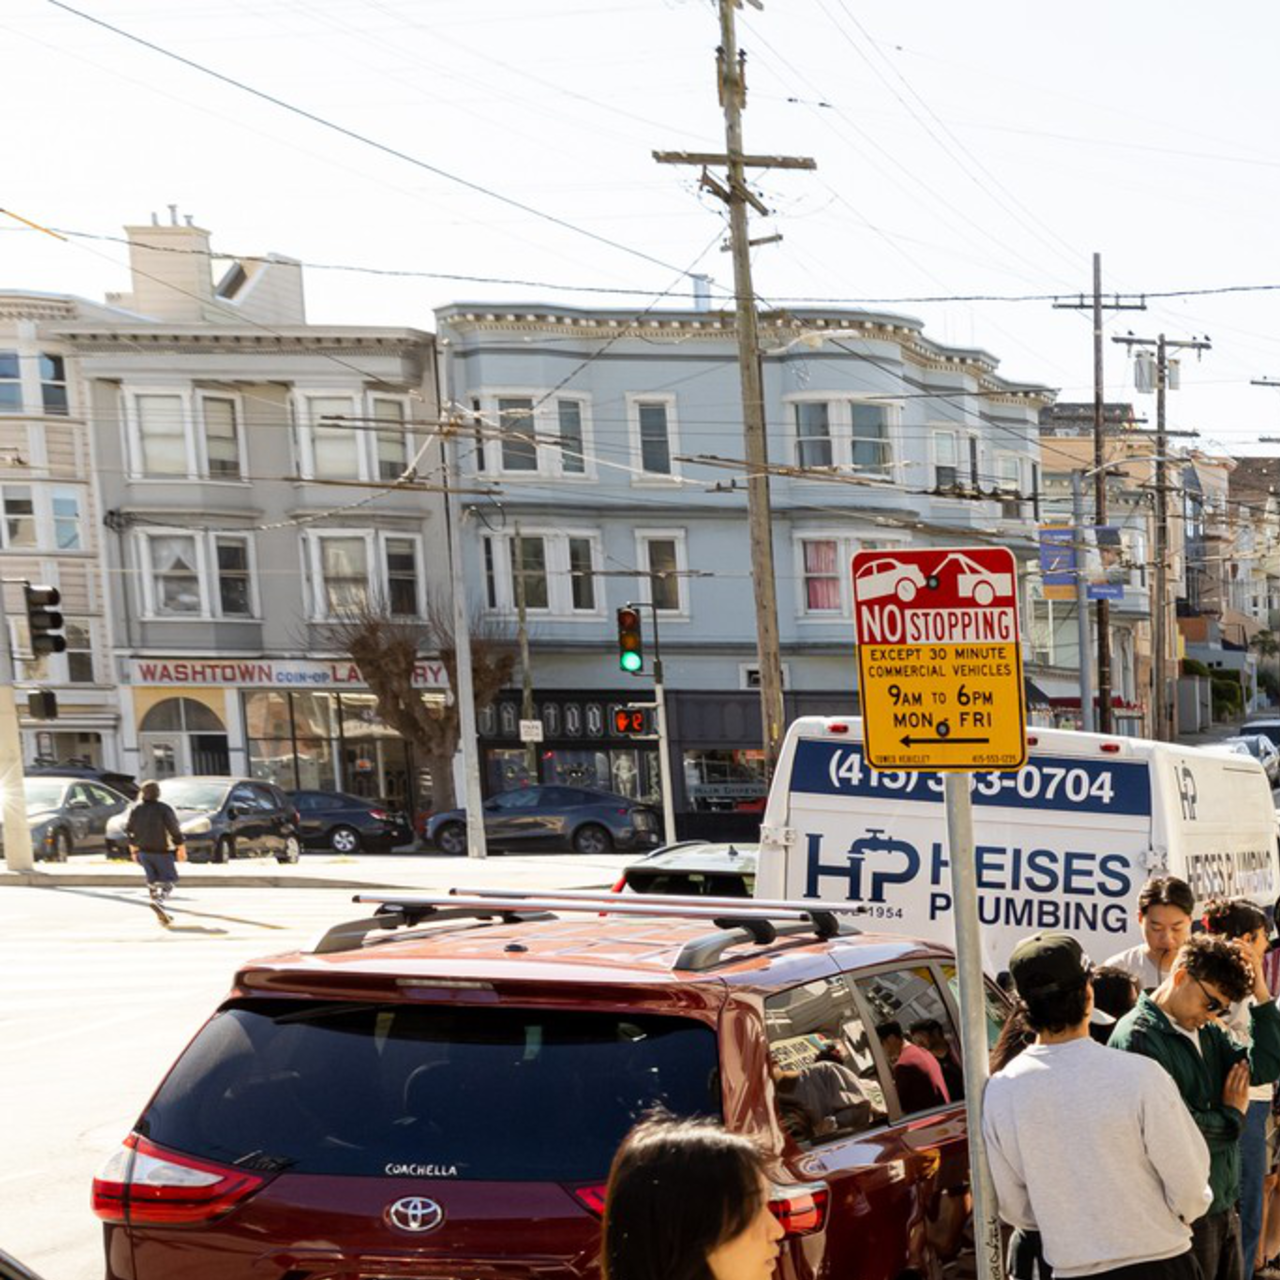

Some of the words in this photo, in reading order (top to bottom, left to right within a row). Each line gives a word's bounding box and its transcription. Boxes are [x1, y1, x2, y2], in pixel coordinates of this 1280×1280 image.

[860, 604, 902, 644] NO
[910, 610, 1011, 642] STOPPING
[870, 648, 922, 661] EXCEPT
[929, 648, 948, 660] 30
[955, 647, 1007, 660] MINUTE
[138, 663, 273, 683] WASHTOWN
[331, 664, 442, 683] LARY
[868, 665, 946, 677] COMMERCIAL
[952, 664, 1012, 676] VEHICLES
[887, 684, 923, 706] 9AM
[932, 691, 947, 704] TO
[956, 684, 994, 706] 6PM
[893, 712, 934, 729] MON
[959, 711, 992, 728] FRI
[868, 906, 904, 919] 1954
[929, 893, 1127, 934] PUMBING
[384, 1163, 458, 1176] COACHELLA
